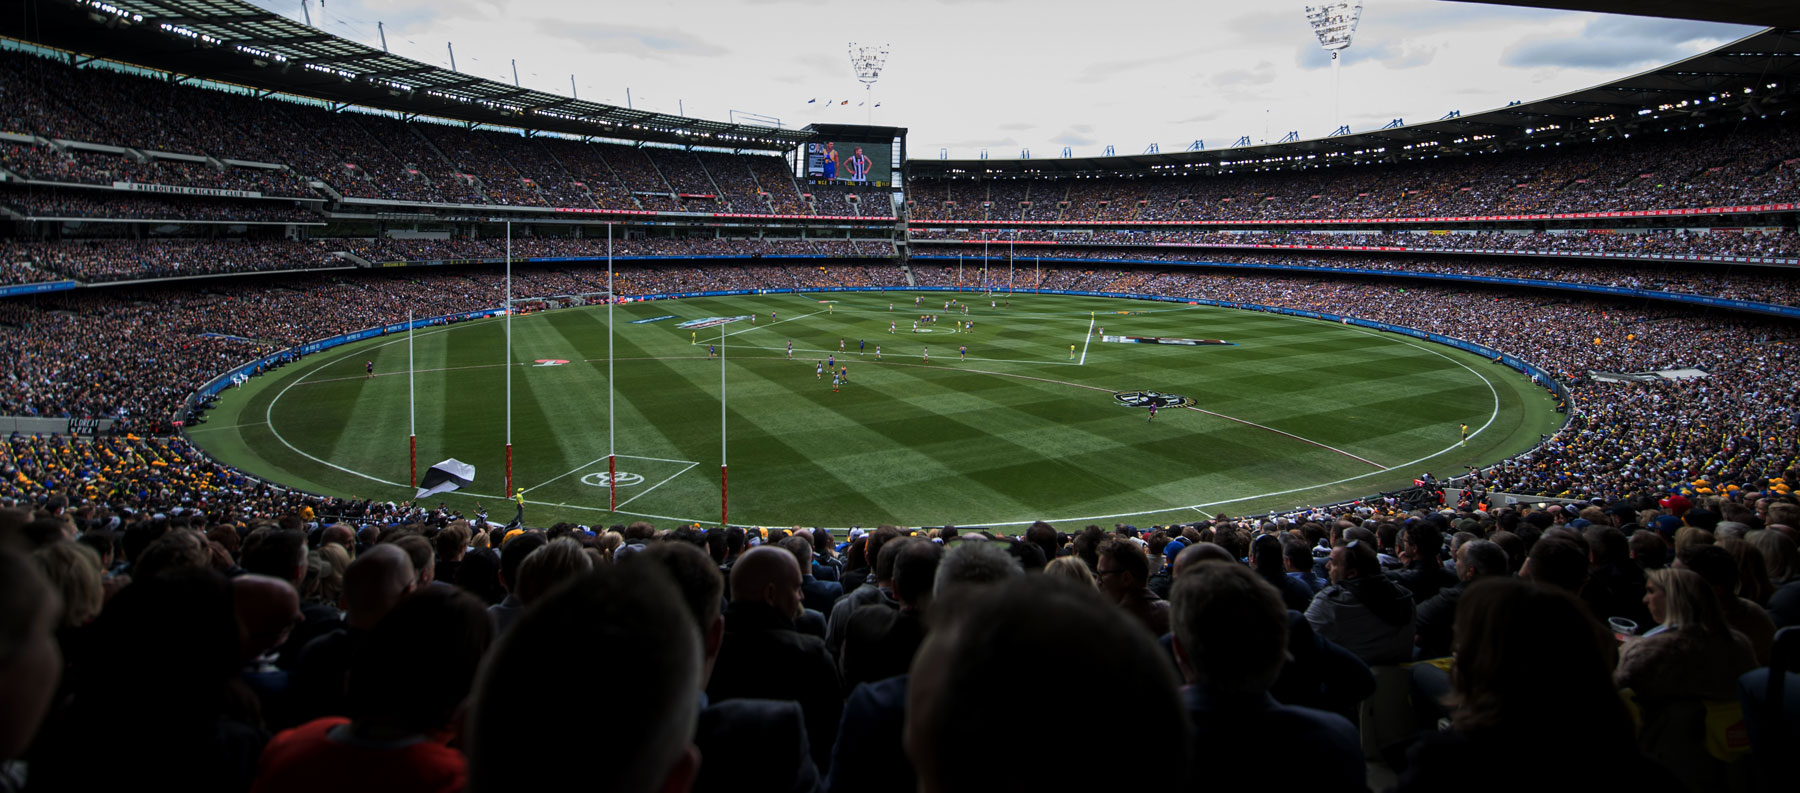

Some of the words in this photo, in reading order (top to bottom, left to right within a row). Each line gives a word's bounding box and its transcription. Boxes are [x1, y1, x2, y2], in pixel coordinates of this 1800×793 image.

[137, 184, 184, 194] MELBOURNE
[188, 188, 222, 196] CRICKET
[70, 419, 100, 427] FLOREAT
